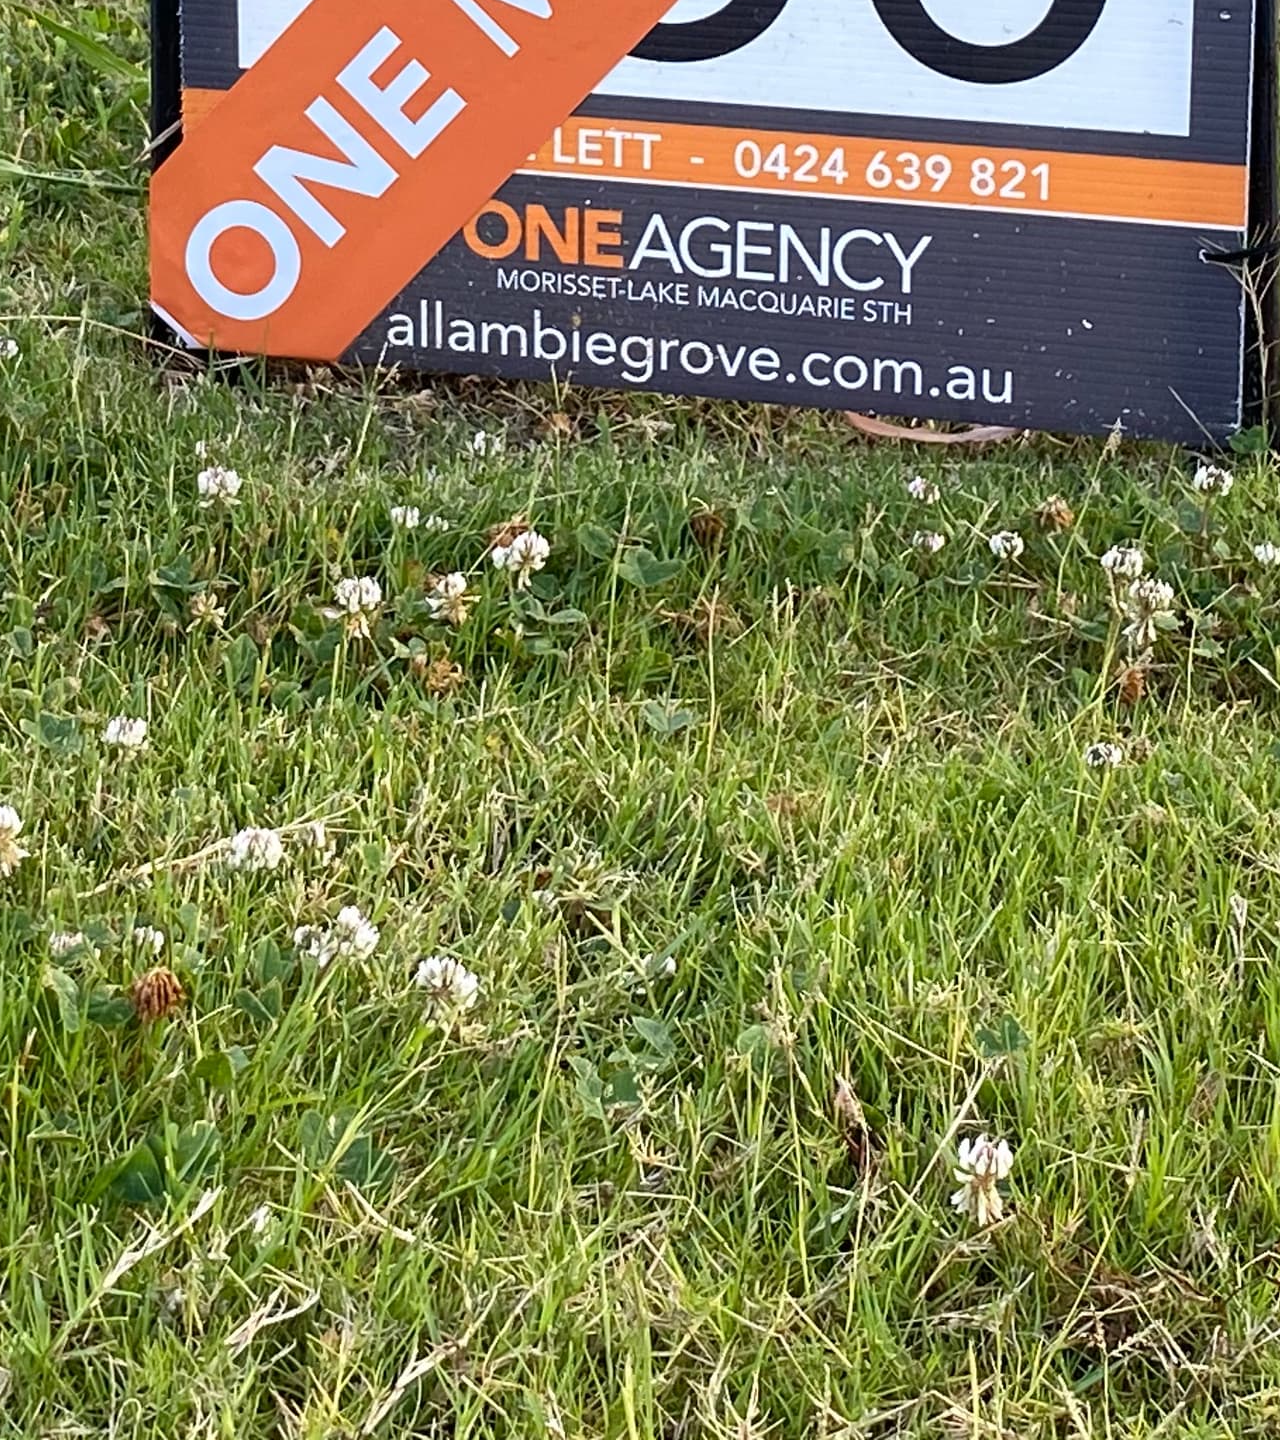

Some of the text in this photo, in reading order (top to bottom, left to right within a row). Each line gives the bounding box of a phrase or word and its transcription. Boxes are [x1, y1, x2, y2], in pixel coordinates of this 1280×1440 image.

[185, 24, 468, 321] ONE
[733, 139, 849, 185] 0424
[865, 150, 953, 192] 639
[969, 157, 1049, 201] 821
[697, 285, 856, 321] MACQUARIE
[862, 300, 913, 325] STH
[386, 298, 1014, 404] allambiegrove.com.au
